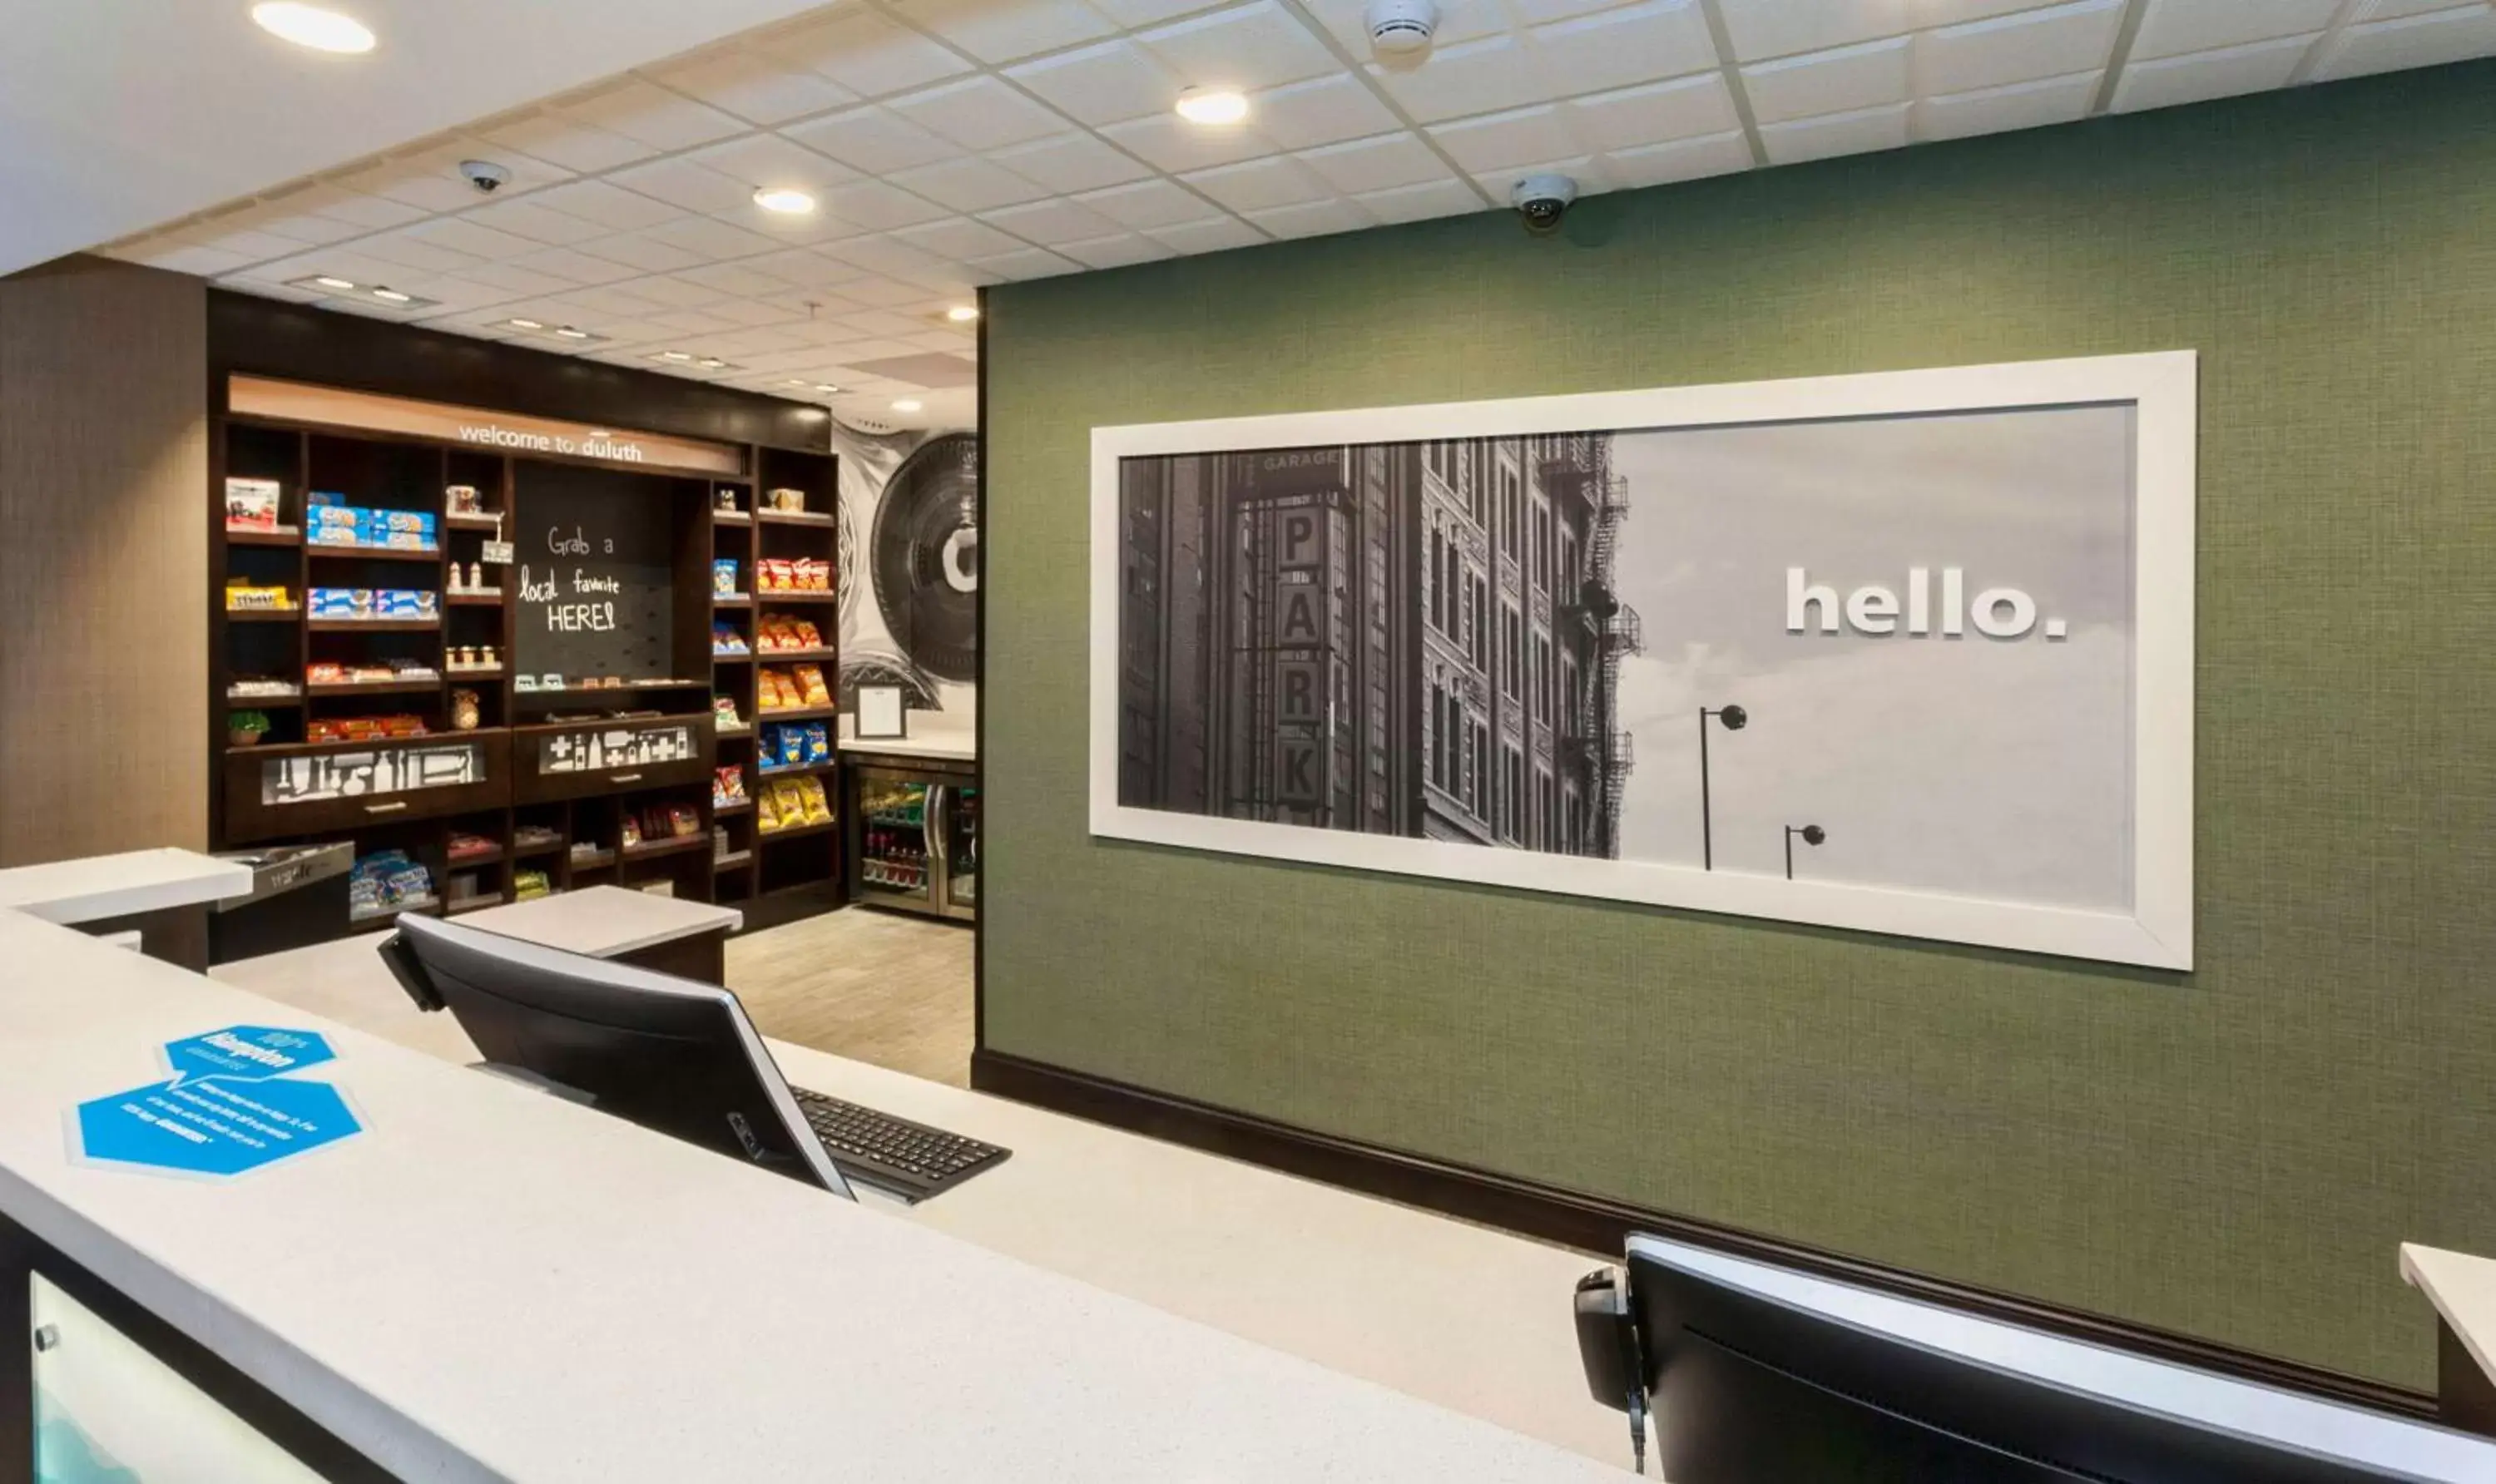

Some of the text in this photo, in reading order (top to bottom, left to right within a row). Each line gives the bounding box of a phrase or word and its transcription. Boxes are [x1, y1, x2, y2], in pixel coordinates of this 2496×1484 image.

[459, 424, 642, 463] welcome to duluth
[1264, 450, 1339, 471] GARAGE
[547, 526, 614, 556] Grab a
[518, 564, 558, 602] local
[547, 601, 615, 632] HERE!
[1785, 566, 2068, 639] hello.
[1285, 514, 1316, 794] PARK
